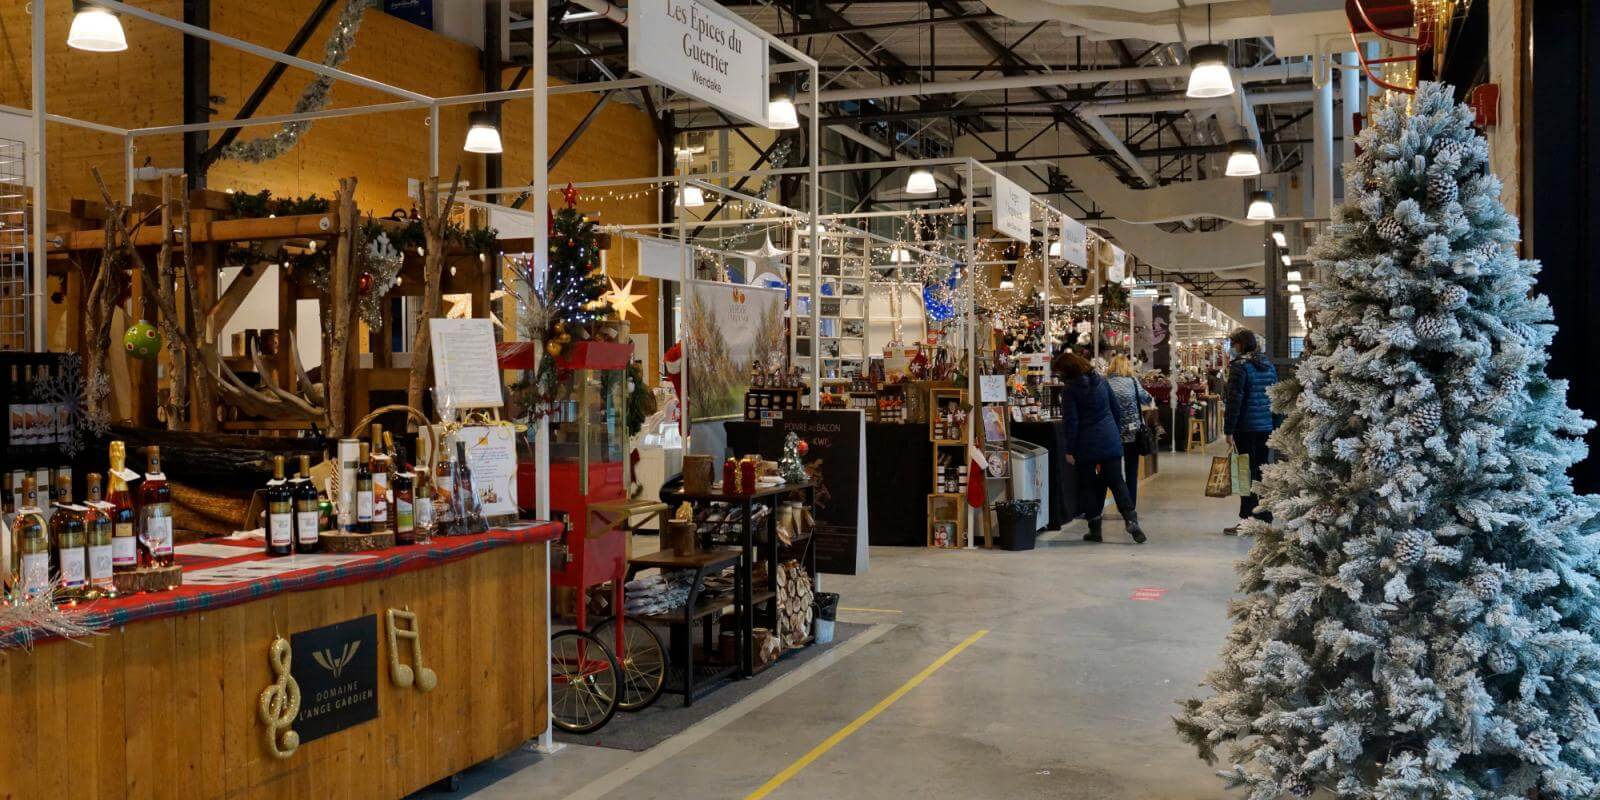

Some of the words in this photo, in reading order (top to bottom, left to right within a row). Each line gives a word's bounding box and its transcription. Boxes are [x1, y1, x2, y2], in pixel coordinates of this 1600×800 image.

[666, 0, 687, 25] Les
[690, 3, 724, 46] Épices
[728, 29, 742, 55] du
[682, 32, 729, 76] Guerrier
[692, 70, 722, 93] Wendake
[784, 422, 807, 432] POIVRE
[816, 423, 841, 432] BACON
[316, 681, 358, 701] DOMAINE
[335, 689, 373, 708] GARDIEN
